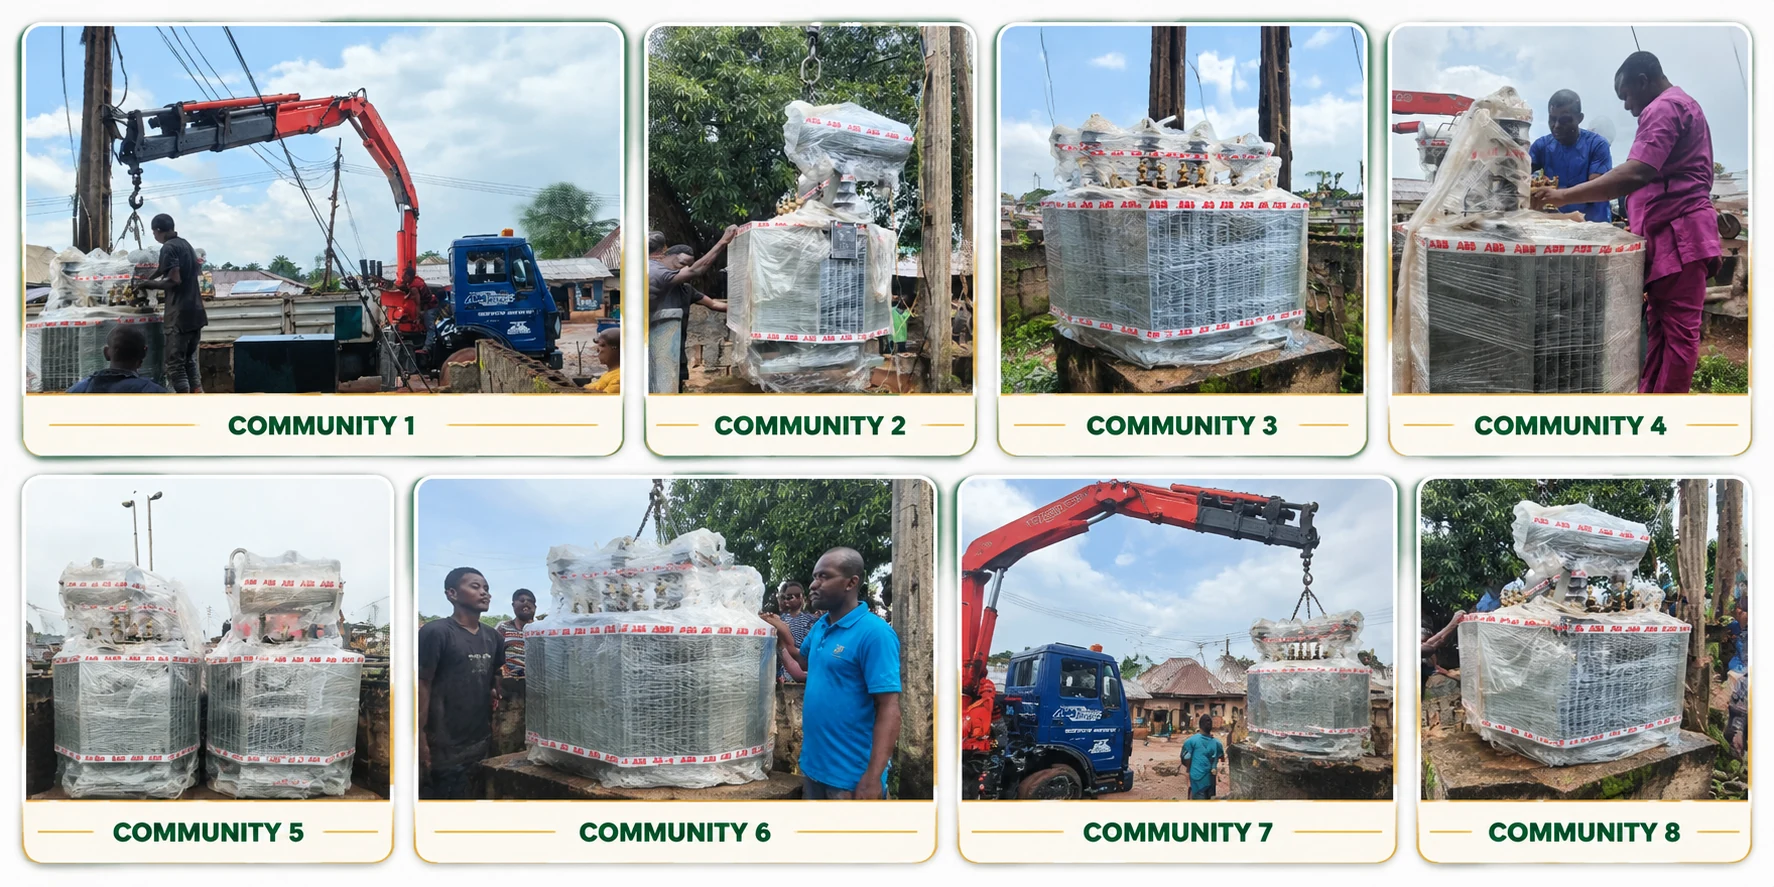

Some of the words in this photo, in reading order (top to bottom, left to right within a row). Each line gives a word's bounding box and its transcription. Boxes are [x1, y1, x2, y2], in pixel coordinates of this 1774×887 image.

[1429, 240, 1449, 249] ABB
[1457, 241, 1476, 251] ABB
[1484, 242, 1505, 253] ABB
[1514, 244, 1536, 255] ABB
